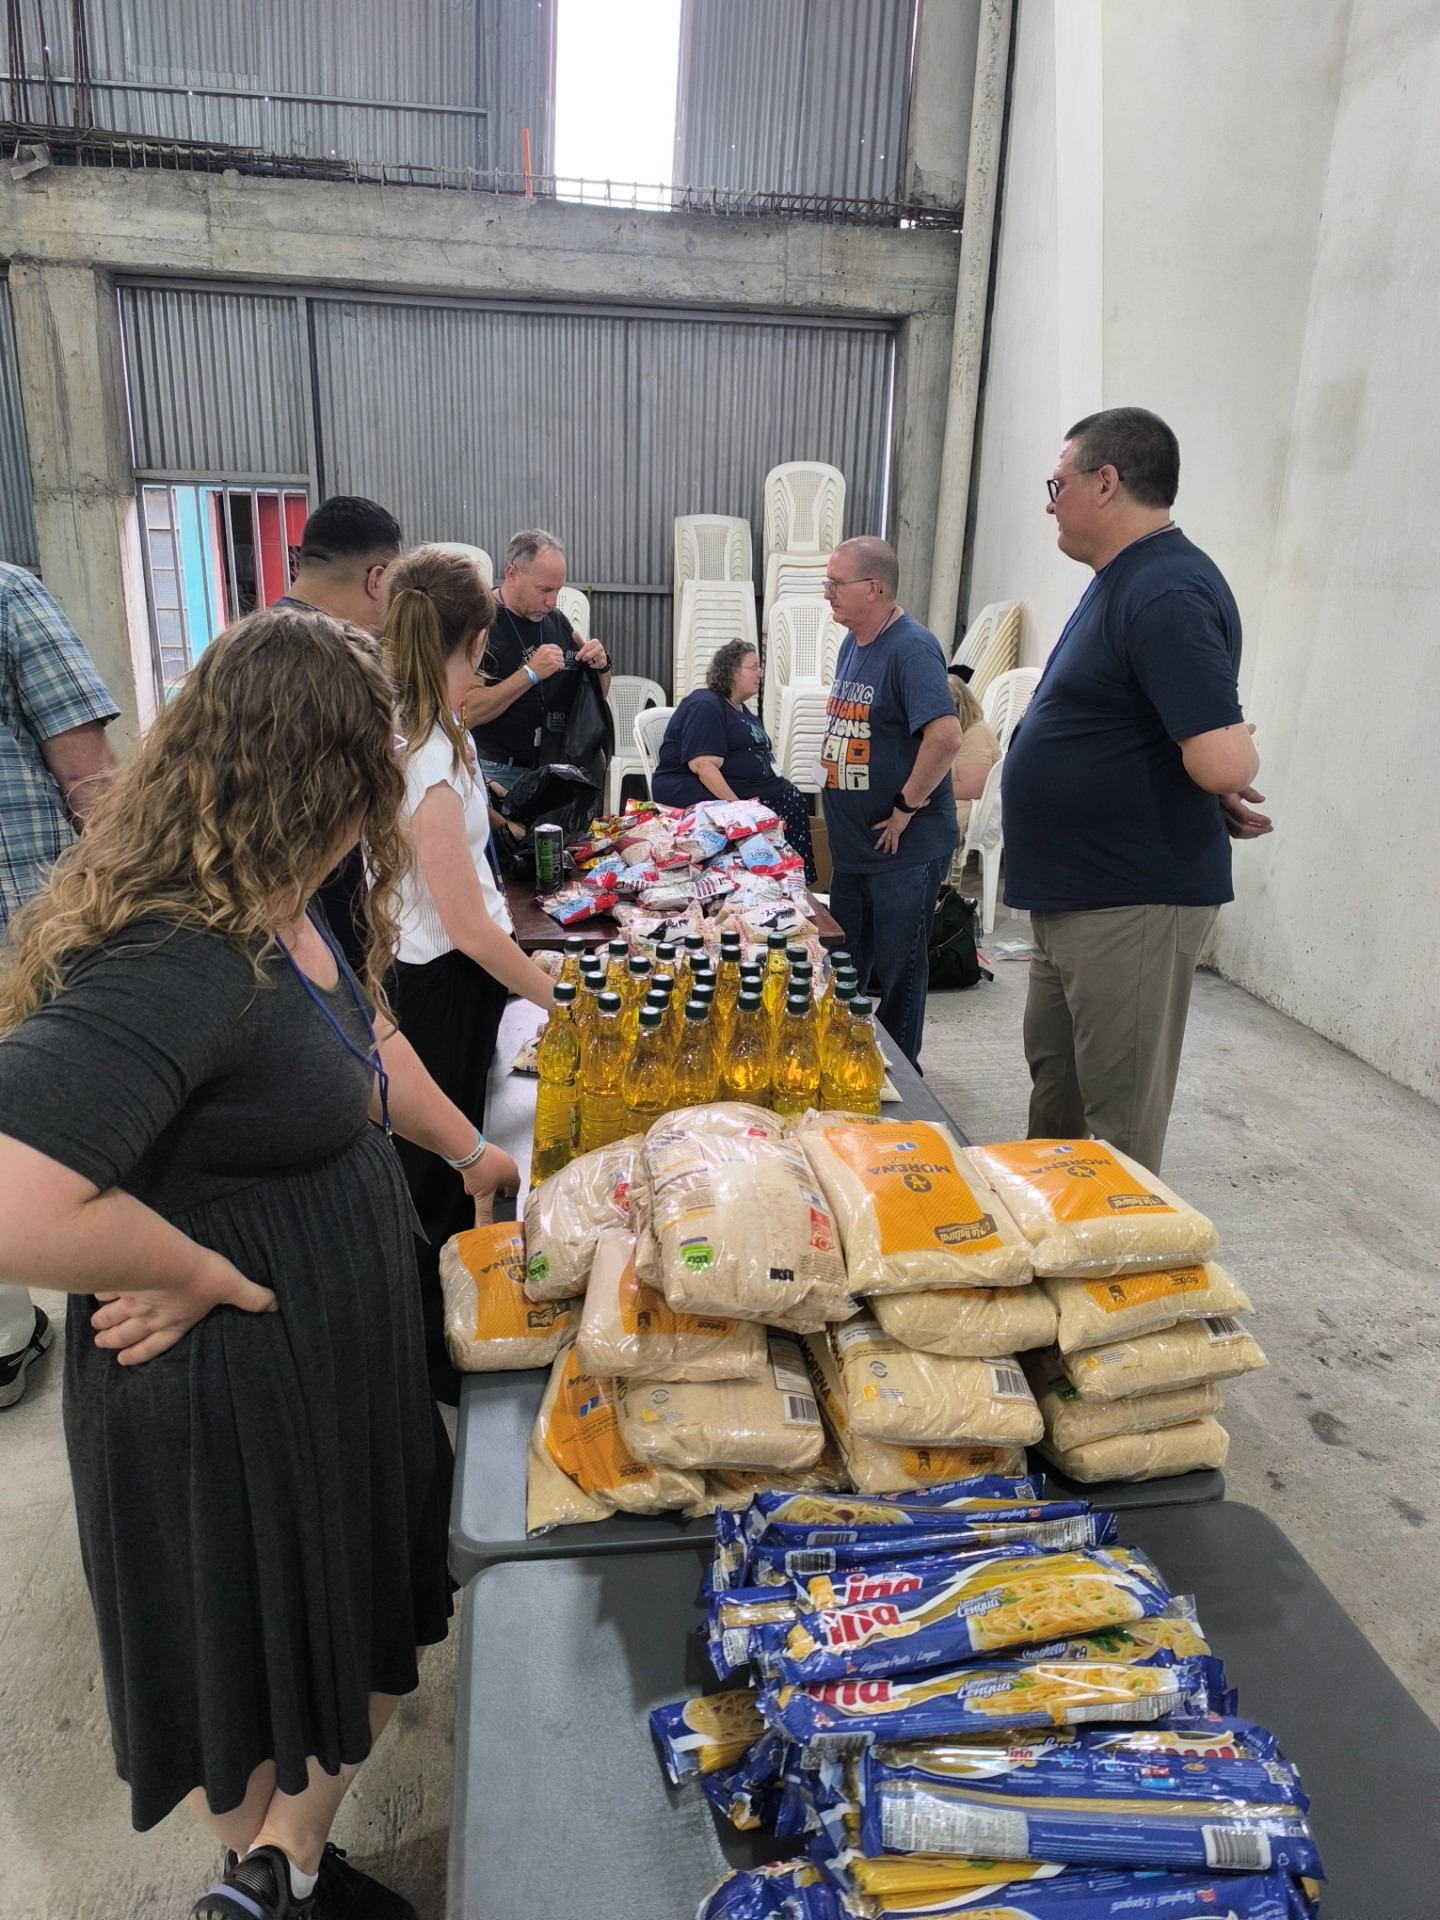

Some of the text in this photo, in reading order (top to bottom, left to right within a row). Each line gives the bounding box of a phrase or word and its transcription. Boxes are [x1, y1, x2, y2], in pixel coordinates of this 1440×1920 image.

[826, 697, 870, 721] ELICAN
[552, 853, 561, 874] BIO
[866, 1163, 951, 1175] MORENA
[1030, 1158, 1112, 1174] MORENA
[687, 1255, 708, 1264] ECO
[529, 1264, 546, 1275] ECO
[957, 1598, 1000, 1618] Lengua
[957, 1682, 1012, 1699] Lengua
